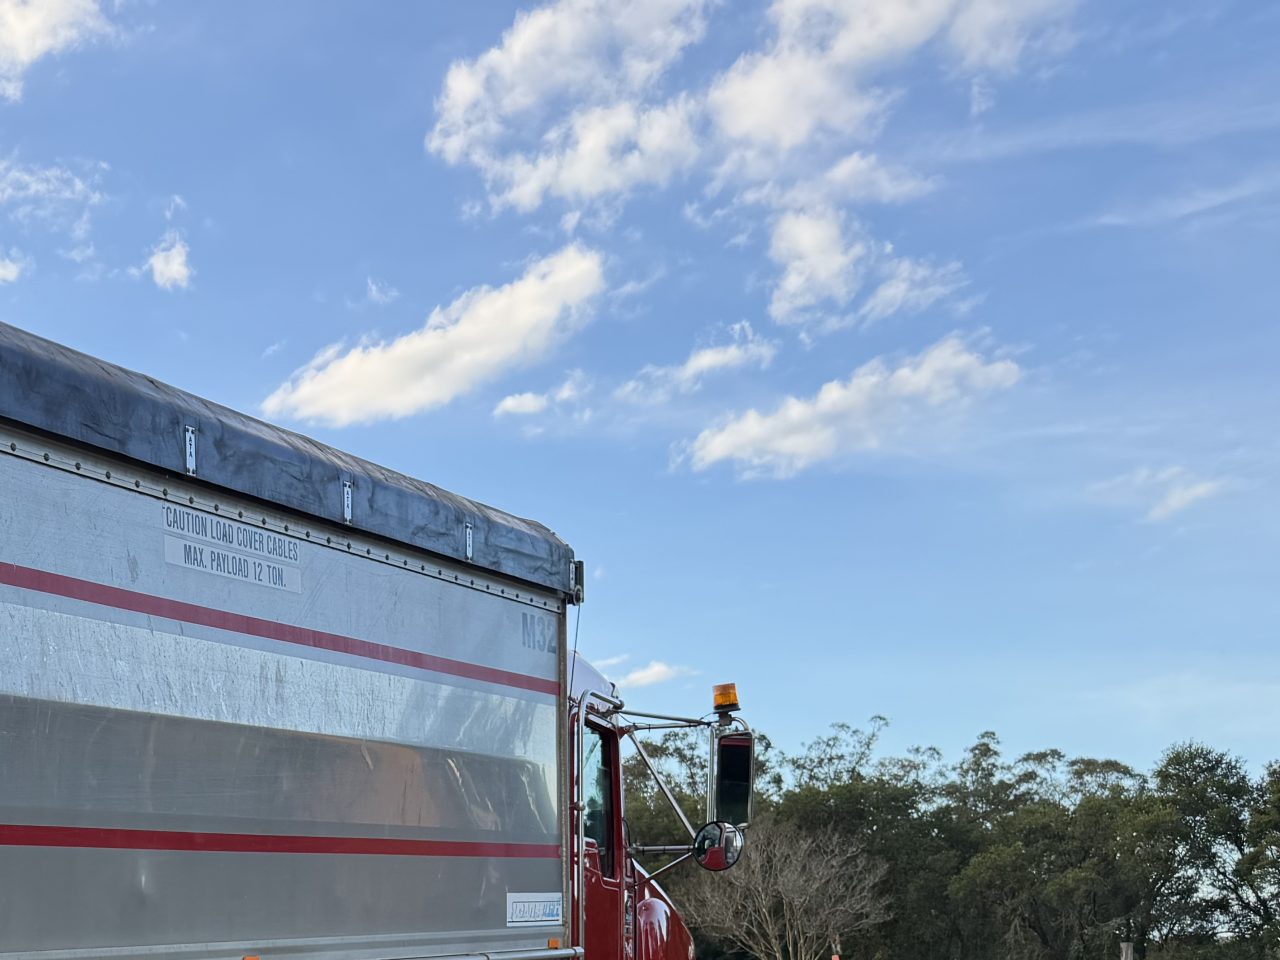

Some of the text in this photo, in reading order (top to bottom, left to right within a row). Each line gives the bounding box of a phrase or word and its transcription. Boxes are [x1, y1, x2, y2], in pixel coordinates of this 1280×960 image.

[166, 507, 299, 561] CAUTION LOAD COVER CABLES
[183, 544, 287, 588] MAX. PAYLOAD 12 TON.
